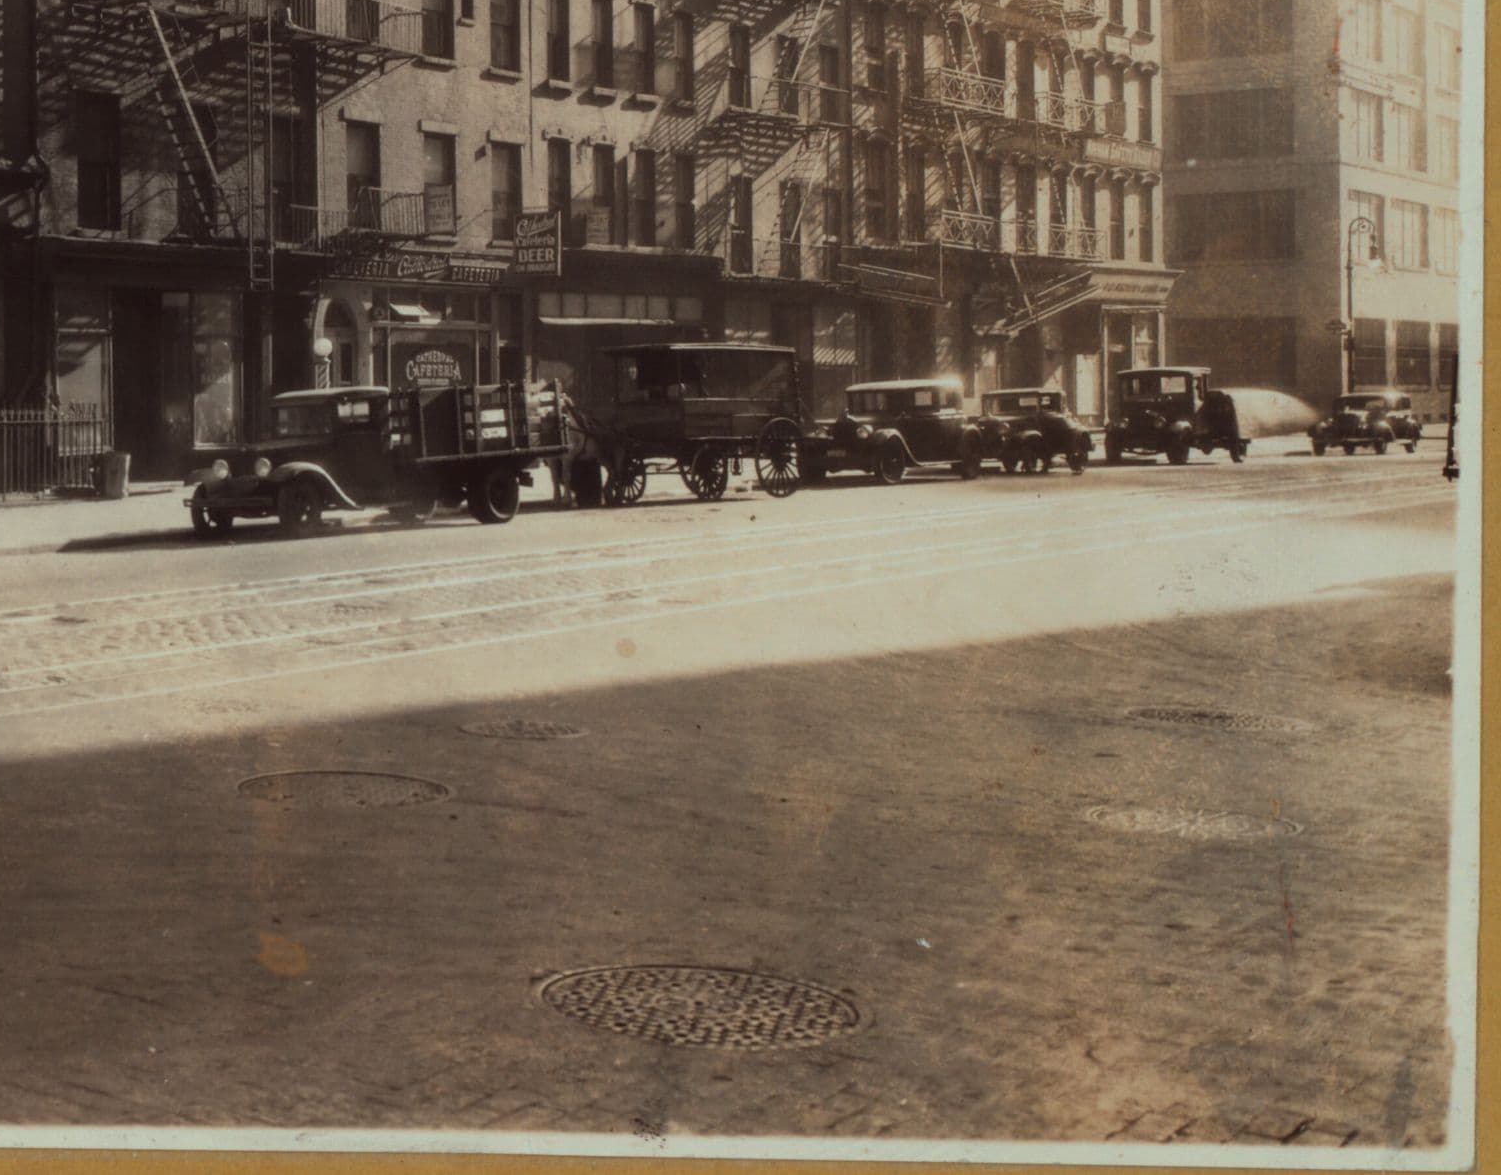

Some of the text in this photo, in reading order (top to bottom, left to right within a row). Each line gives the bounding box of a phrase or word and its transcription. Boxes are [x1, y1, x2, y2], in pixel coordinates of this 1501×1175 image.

[515, 234, 555, 247] Cafeteria
[451, 266, 501, 283] CAFETERIA
[405, 360, 462, 381] CAFETERIA
